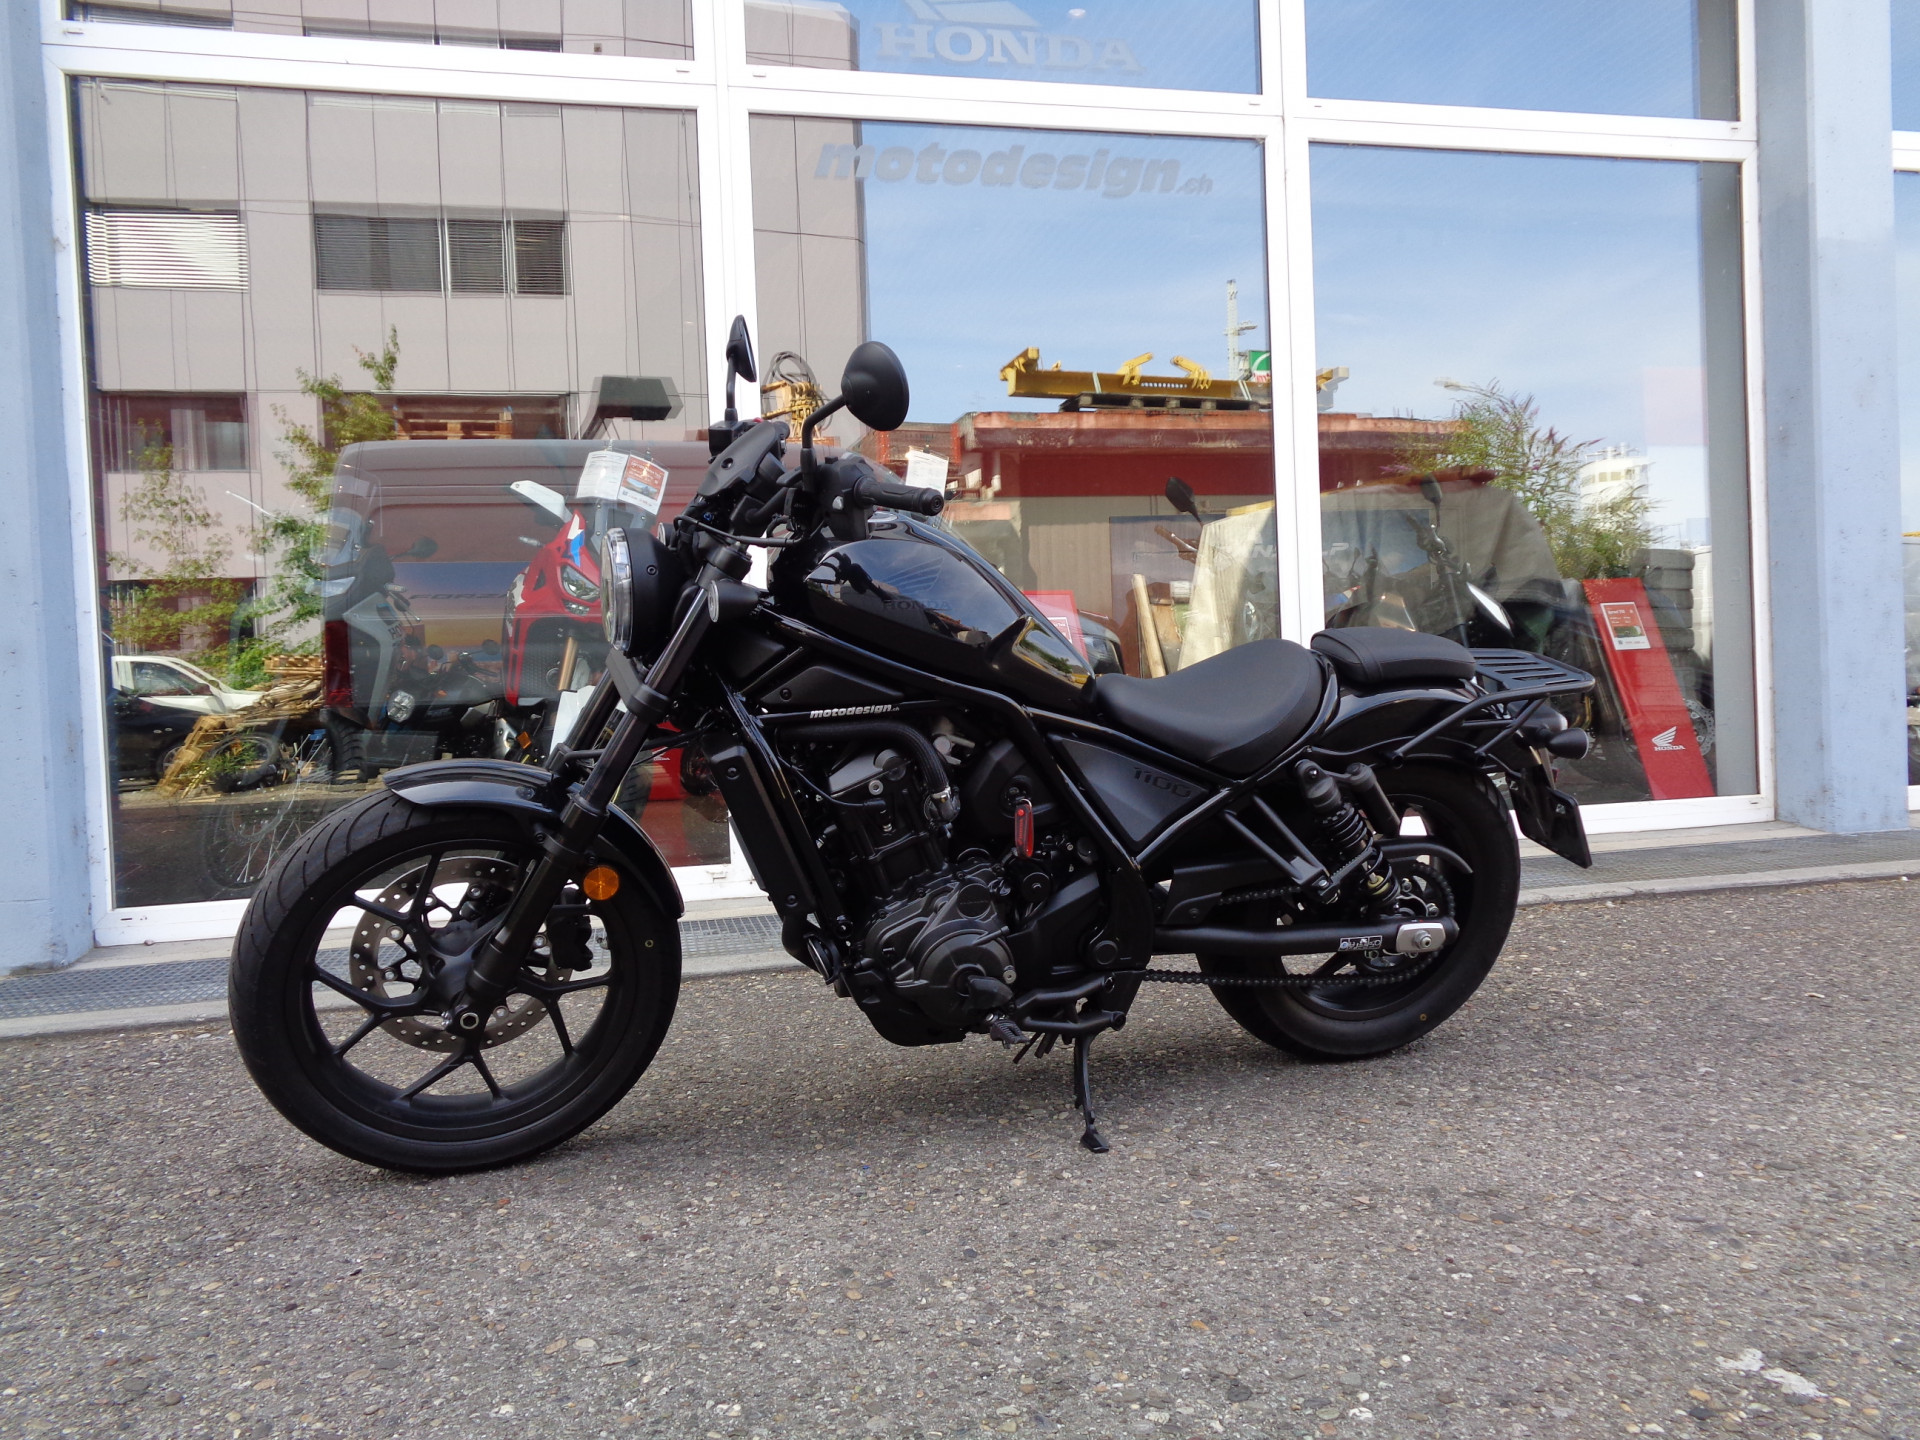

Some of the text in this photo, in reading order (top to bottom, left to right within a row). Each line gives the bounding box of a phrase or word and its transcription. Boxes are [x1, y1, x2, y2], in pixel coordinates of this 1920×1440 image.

[875, 21, 1147, 75] HONDA
[813, 142, 1214, 200] motodesign.ch
[809, 704, 900, 719] motodesign.ch
[1133, 766, 1192, 798] 1100
